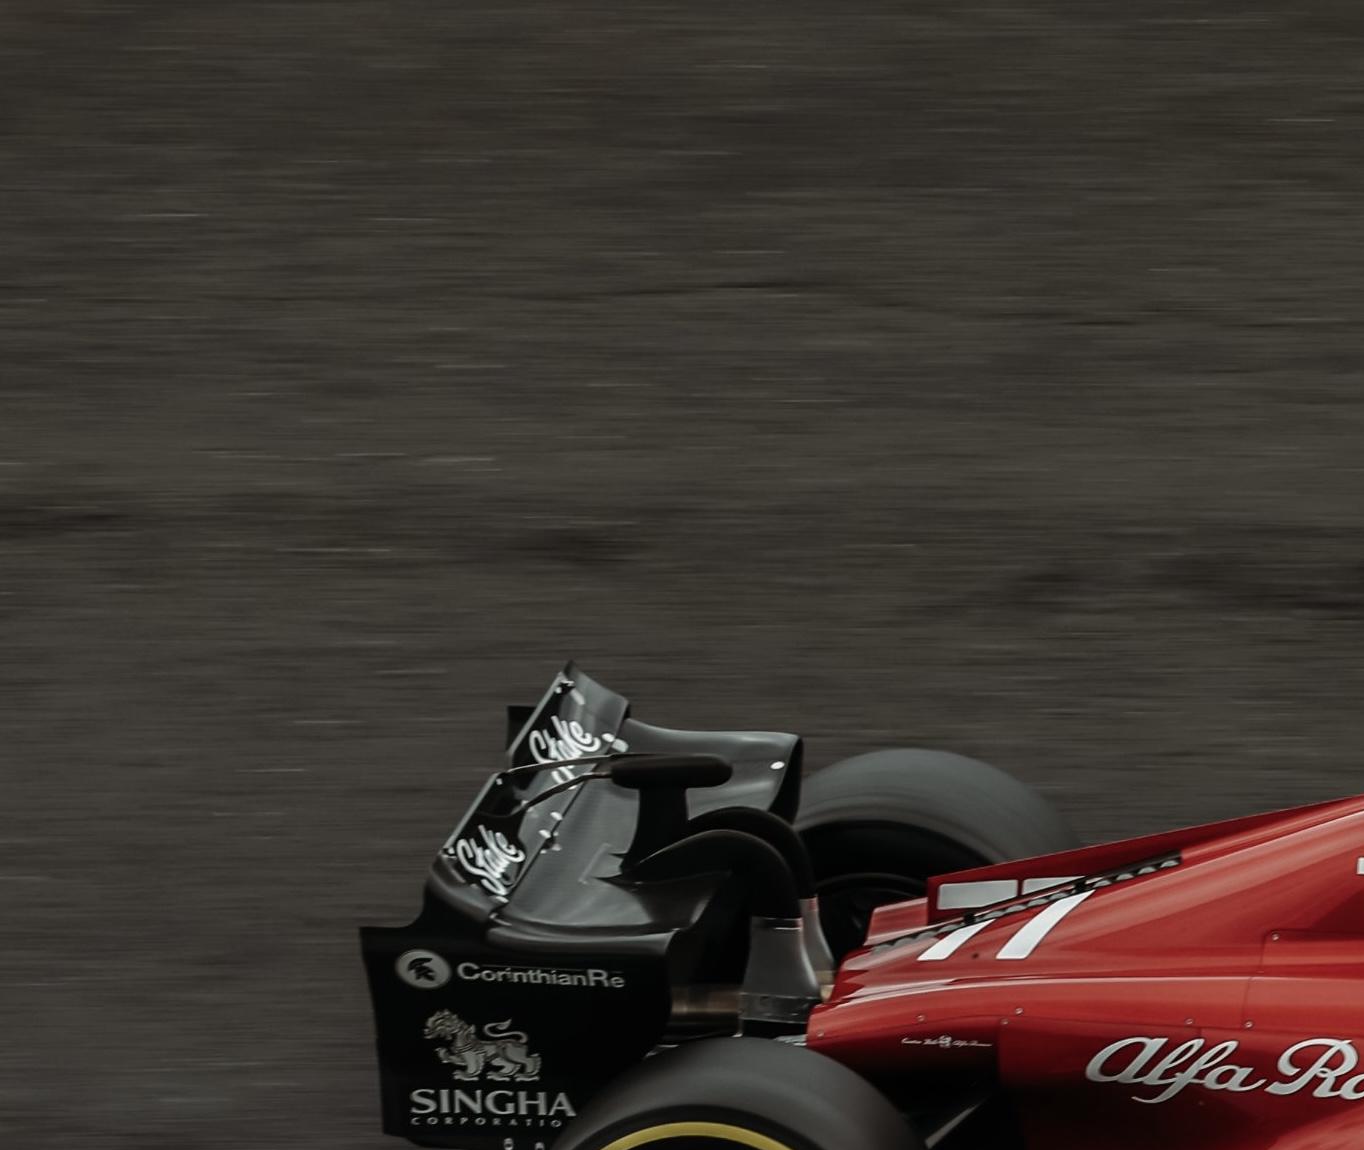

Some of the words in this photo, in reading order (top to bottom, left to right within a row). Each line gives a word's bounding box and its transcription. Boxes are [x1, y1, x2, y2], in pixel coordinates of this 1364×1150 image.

[457, 825, 525, 893] Stake
[457, 962, 625, 988] CorinthianRe
[1087, 1037, 1266, 1103] Alfa
[411, 1089, 576, 1117] SINGHA
[411, 1117, 562, 1128] CORPORATIO
